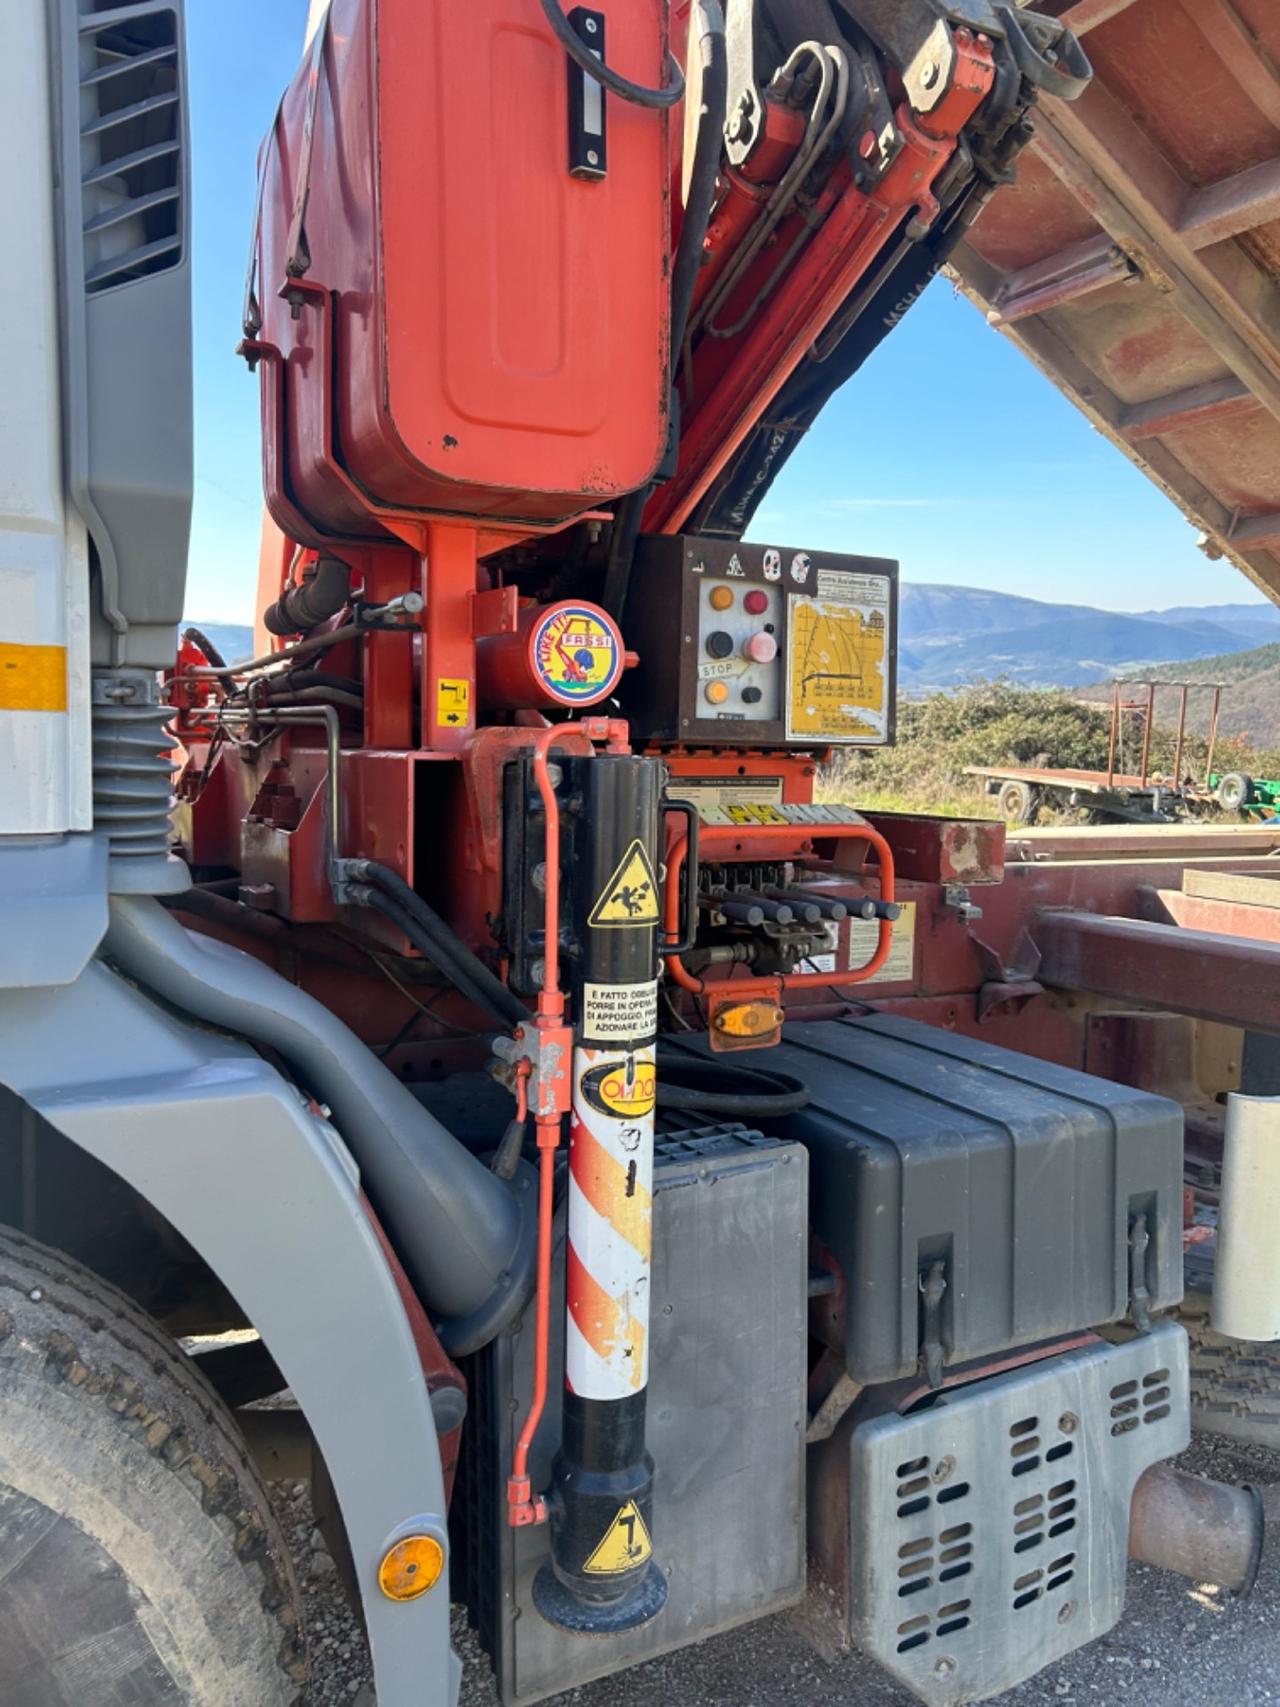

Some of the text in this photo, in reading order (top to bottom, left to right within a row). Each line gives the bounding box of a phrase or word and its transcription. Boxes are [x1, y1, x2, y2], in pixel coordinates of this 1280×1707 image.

[564, 635, 611, 647] FASSI
[541, 632, 555, 662] LIKE
[703, 664, 732, 677] STOP
[600, 992, 628, 1000] FATTO
[587, 1001, 615, 1010] PORRE
[617, 1002, 627, 1010] IN
[595, 1022, 637, 1032] AZIONARE
